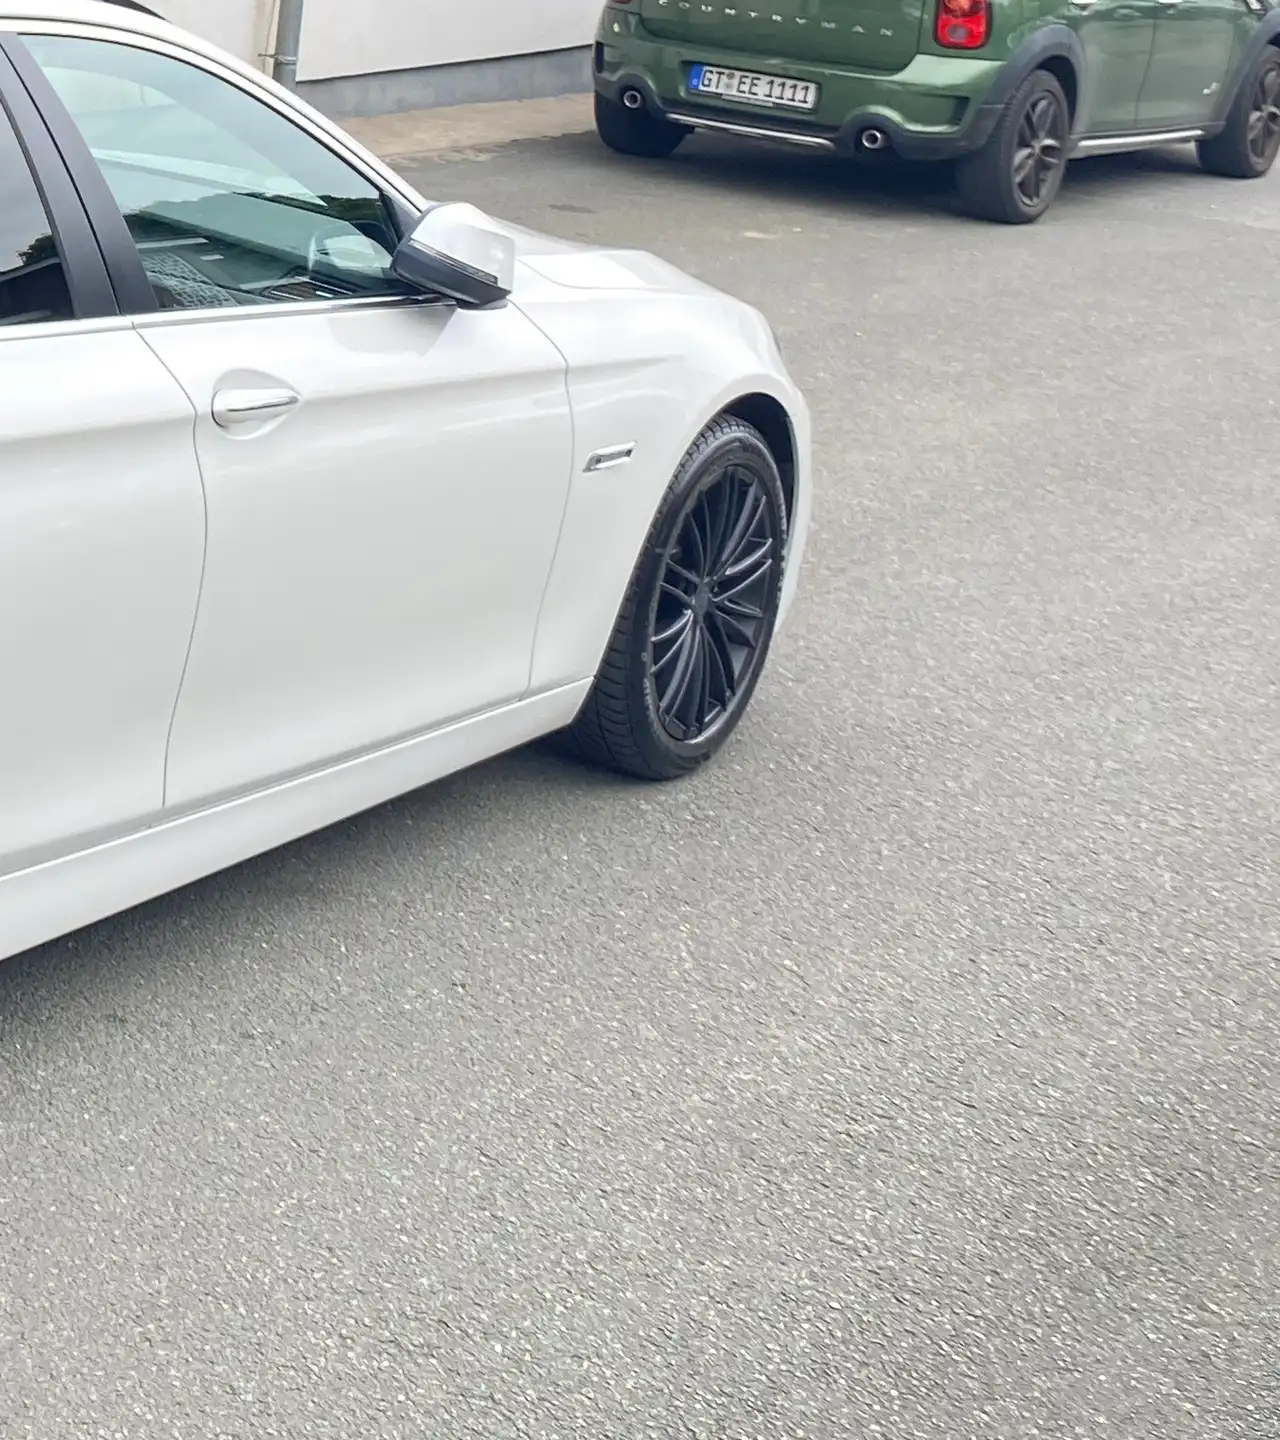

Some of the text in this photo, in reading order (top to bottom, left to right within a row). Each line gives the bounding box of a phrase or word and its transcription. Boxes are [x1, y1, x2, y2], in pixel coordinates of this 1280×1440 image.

[701, 69, 810, 104] GT EE 1111
